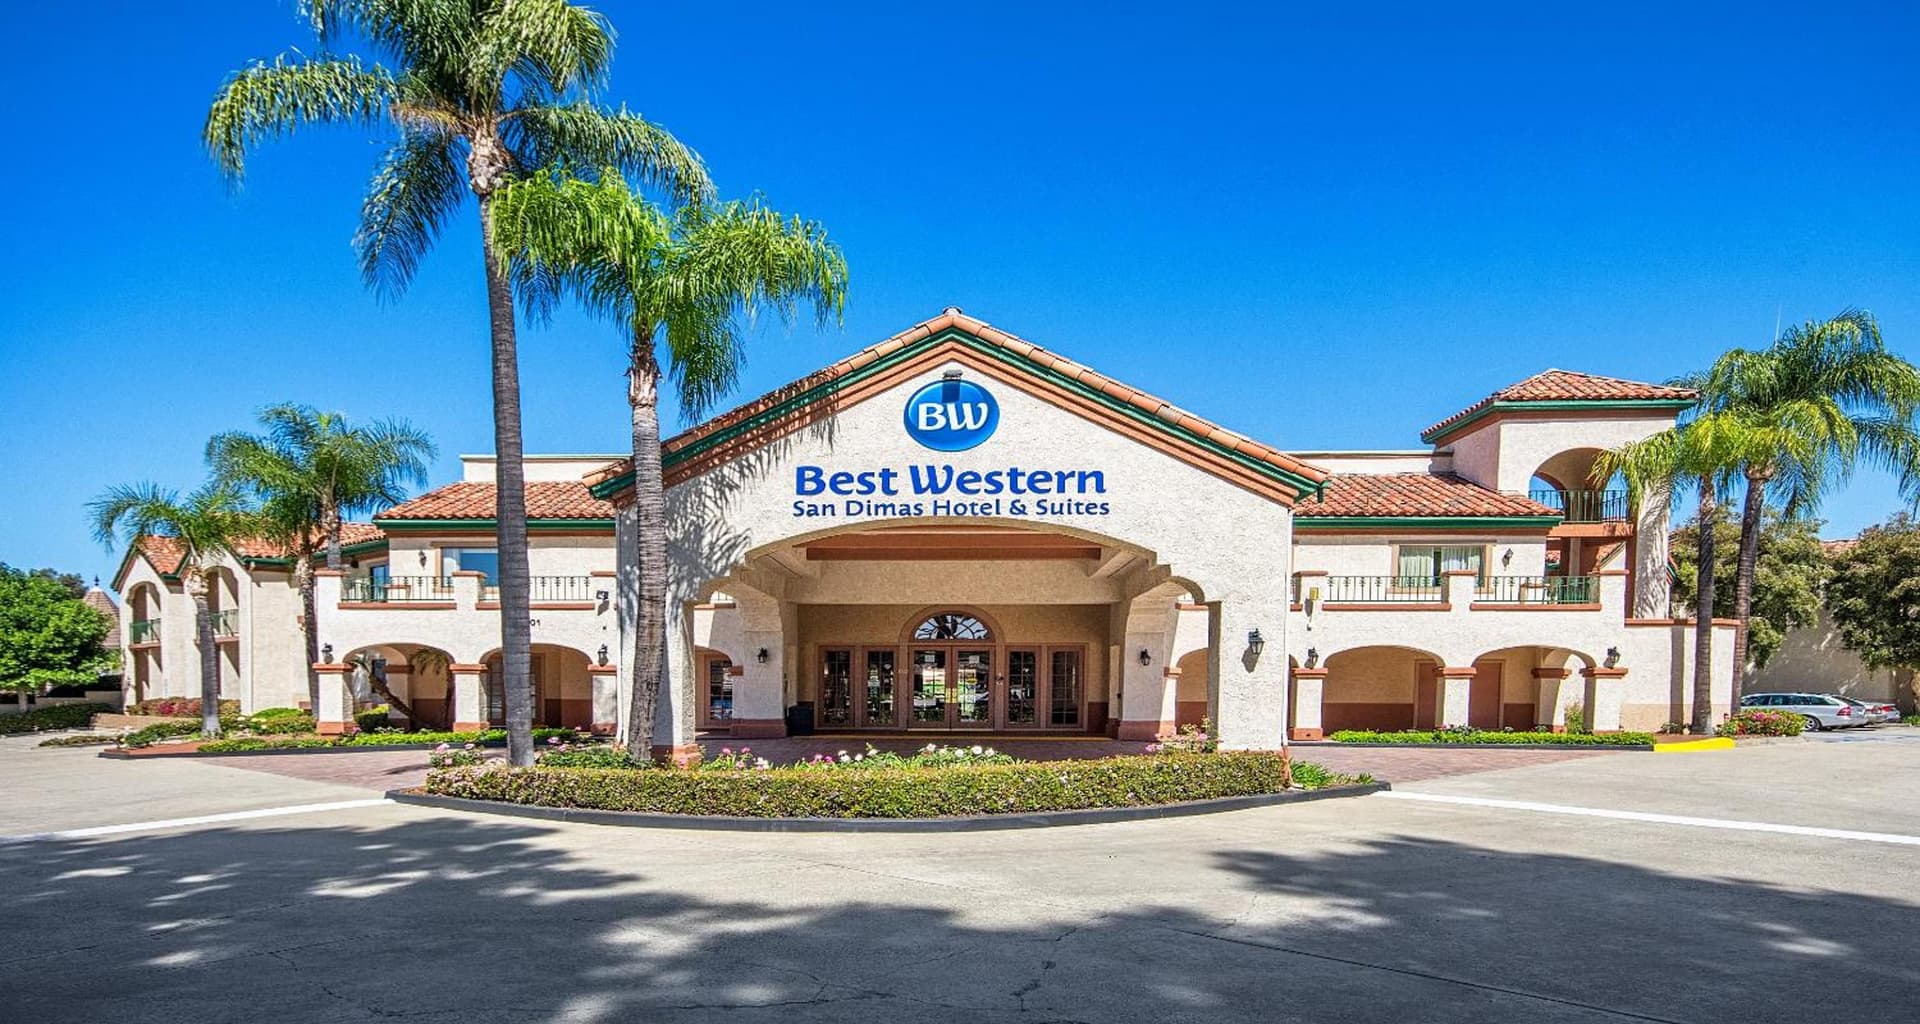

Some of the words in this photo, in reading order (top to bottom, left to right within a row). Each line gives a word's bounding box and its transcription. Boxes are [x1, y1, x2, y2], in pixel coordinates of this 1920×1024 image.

[918, 402, 989, 431] BW
[795, 465, 898, 496] Best
[909, 465, 1106, 496] Western
[793, 500, 834, 517] San
[846, 500, 924, 517] Dimas
[932, 499, 1001, 516] Hotel
[1009, 499, 1027, 516] &
[1036, 499, 1110, 516] Suites
[529, 618, 541, 627] 01
